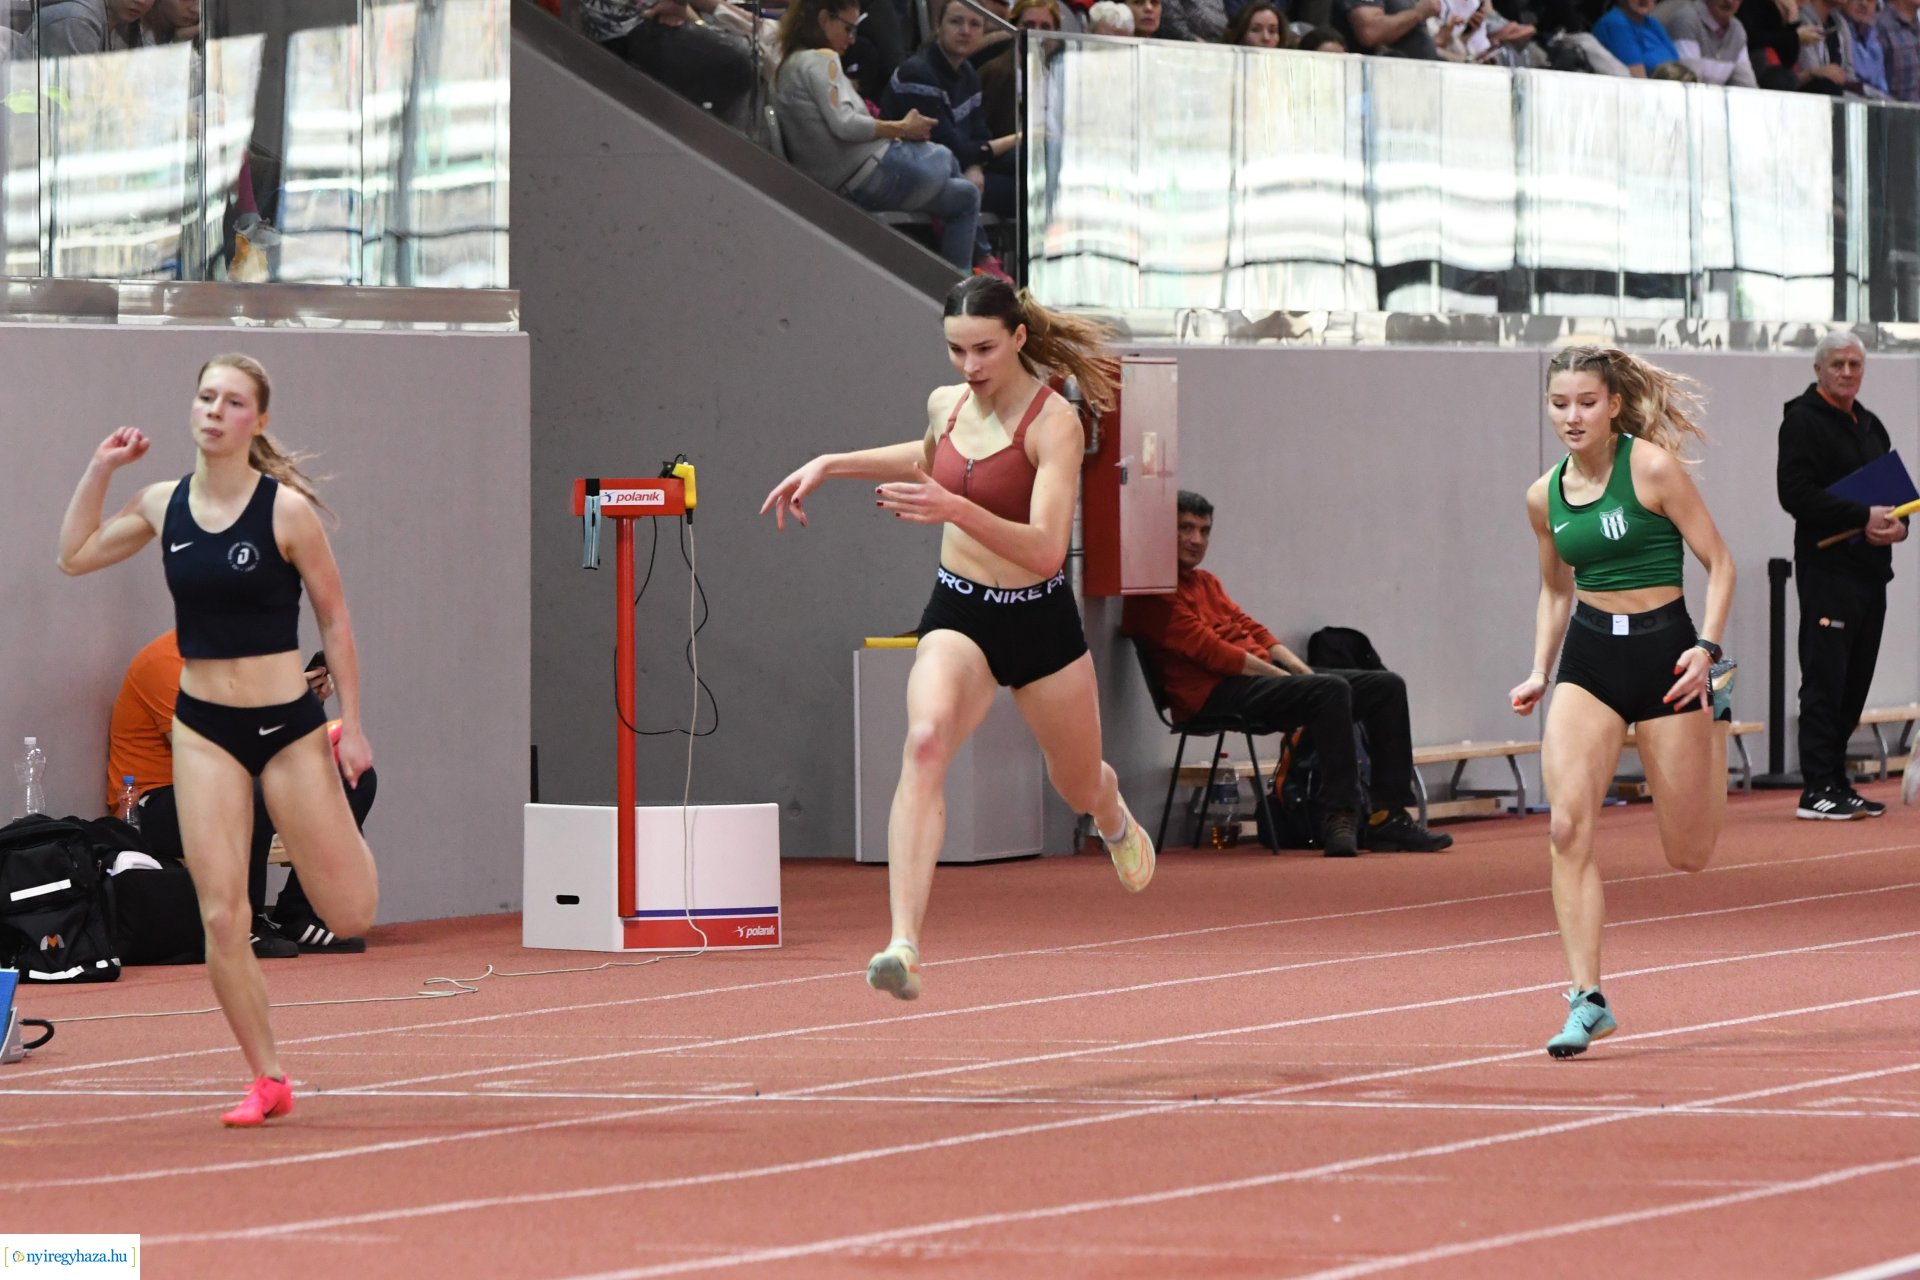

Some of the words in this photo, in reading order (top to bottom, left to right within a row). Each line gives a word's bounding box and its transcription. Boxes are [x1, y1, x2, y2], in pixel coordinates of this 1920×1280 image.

[616, 492, 660, 504] polanik
[937, 567, 974, 595] PRO
[983, 584, 1043, 604] NIKE
[745, 925, 776, 939] polanik
